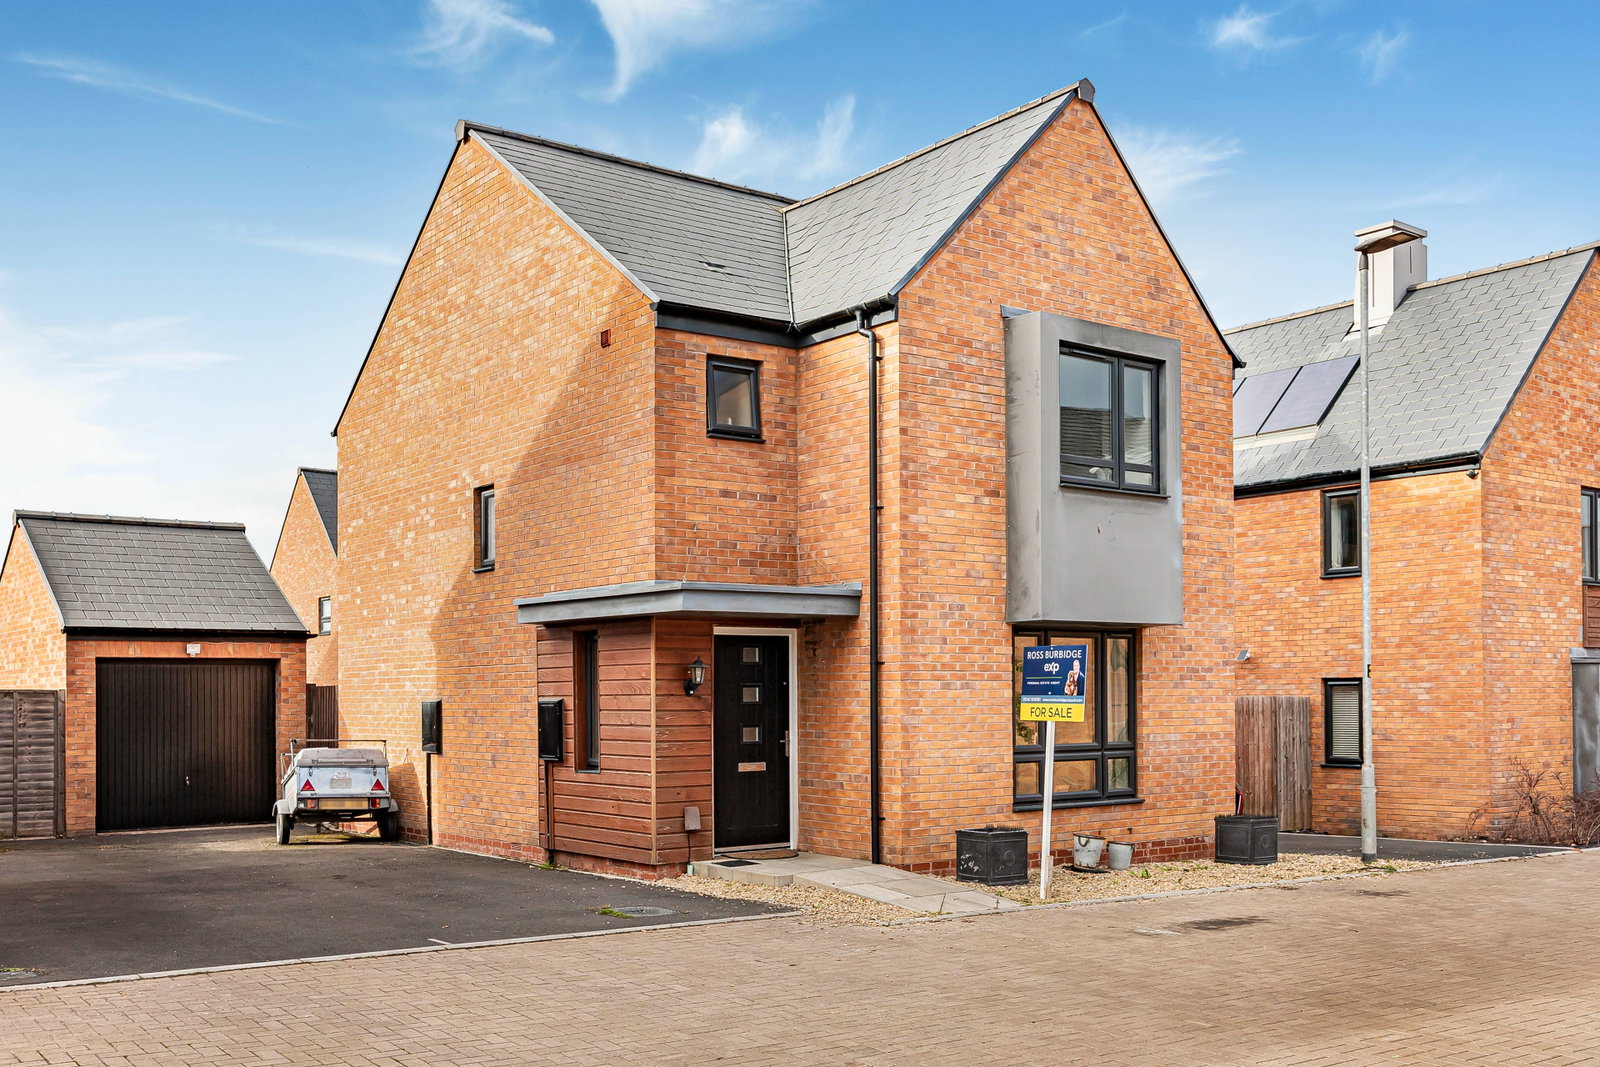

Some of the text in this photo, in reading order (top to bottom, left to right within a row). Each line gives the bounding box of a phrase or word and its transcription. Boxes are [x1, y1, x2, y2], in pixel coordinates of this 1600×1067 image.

[1027, 650, 1082, 659] ROSS BURBIDGE
[1030, 707, 1072, 718] FOR SALE
